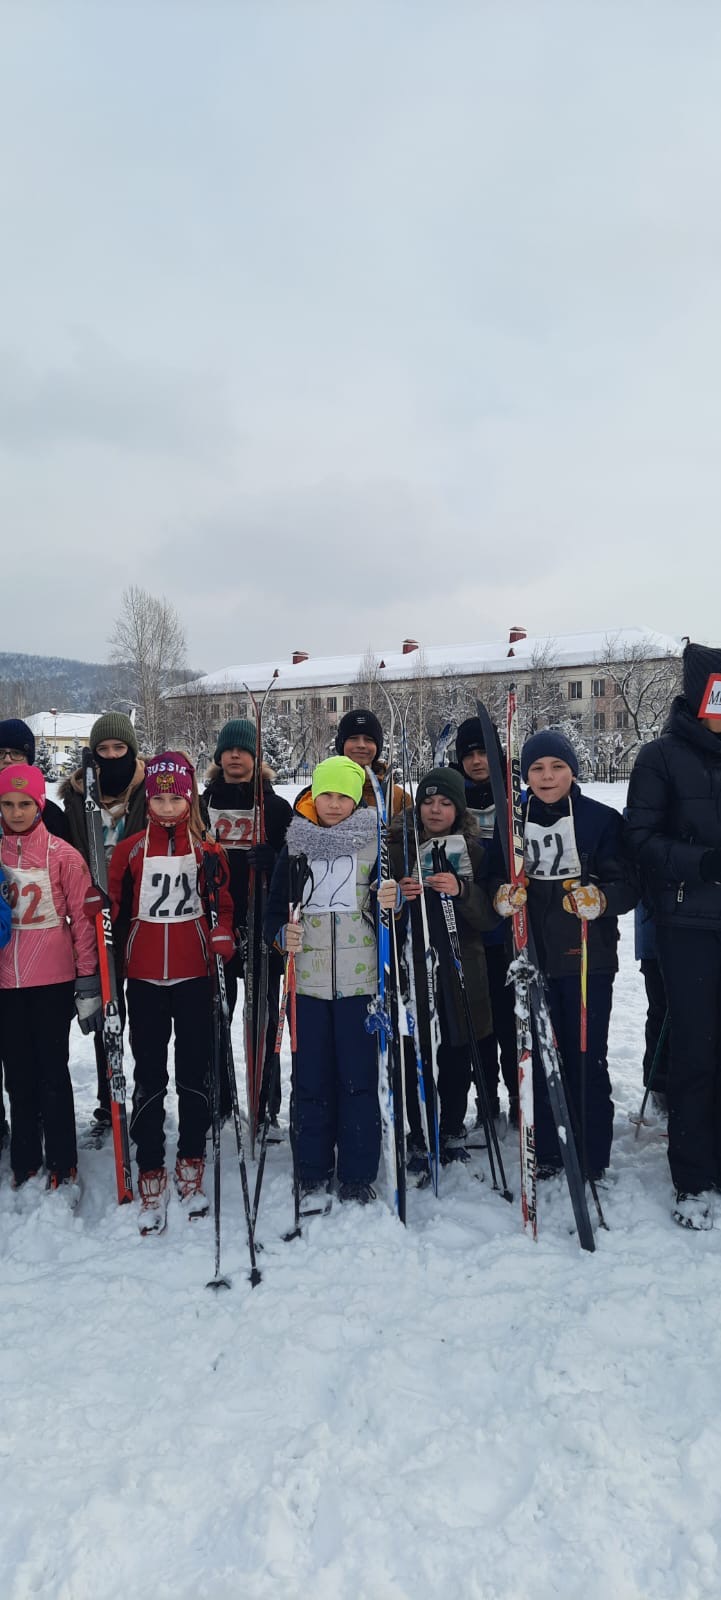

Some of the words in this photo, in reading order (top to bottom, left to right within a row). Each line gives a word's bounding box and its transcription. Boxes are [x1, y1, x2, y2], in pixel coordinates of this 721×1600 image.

[146, 761, 187, 776] RUSSIA
[149, 873, 194, 917] 22
[306, 854, 354, 908] 22
[380, 818, 390, 928] NDWAY
[101, 908, 113, 947] TISA
